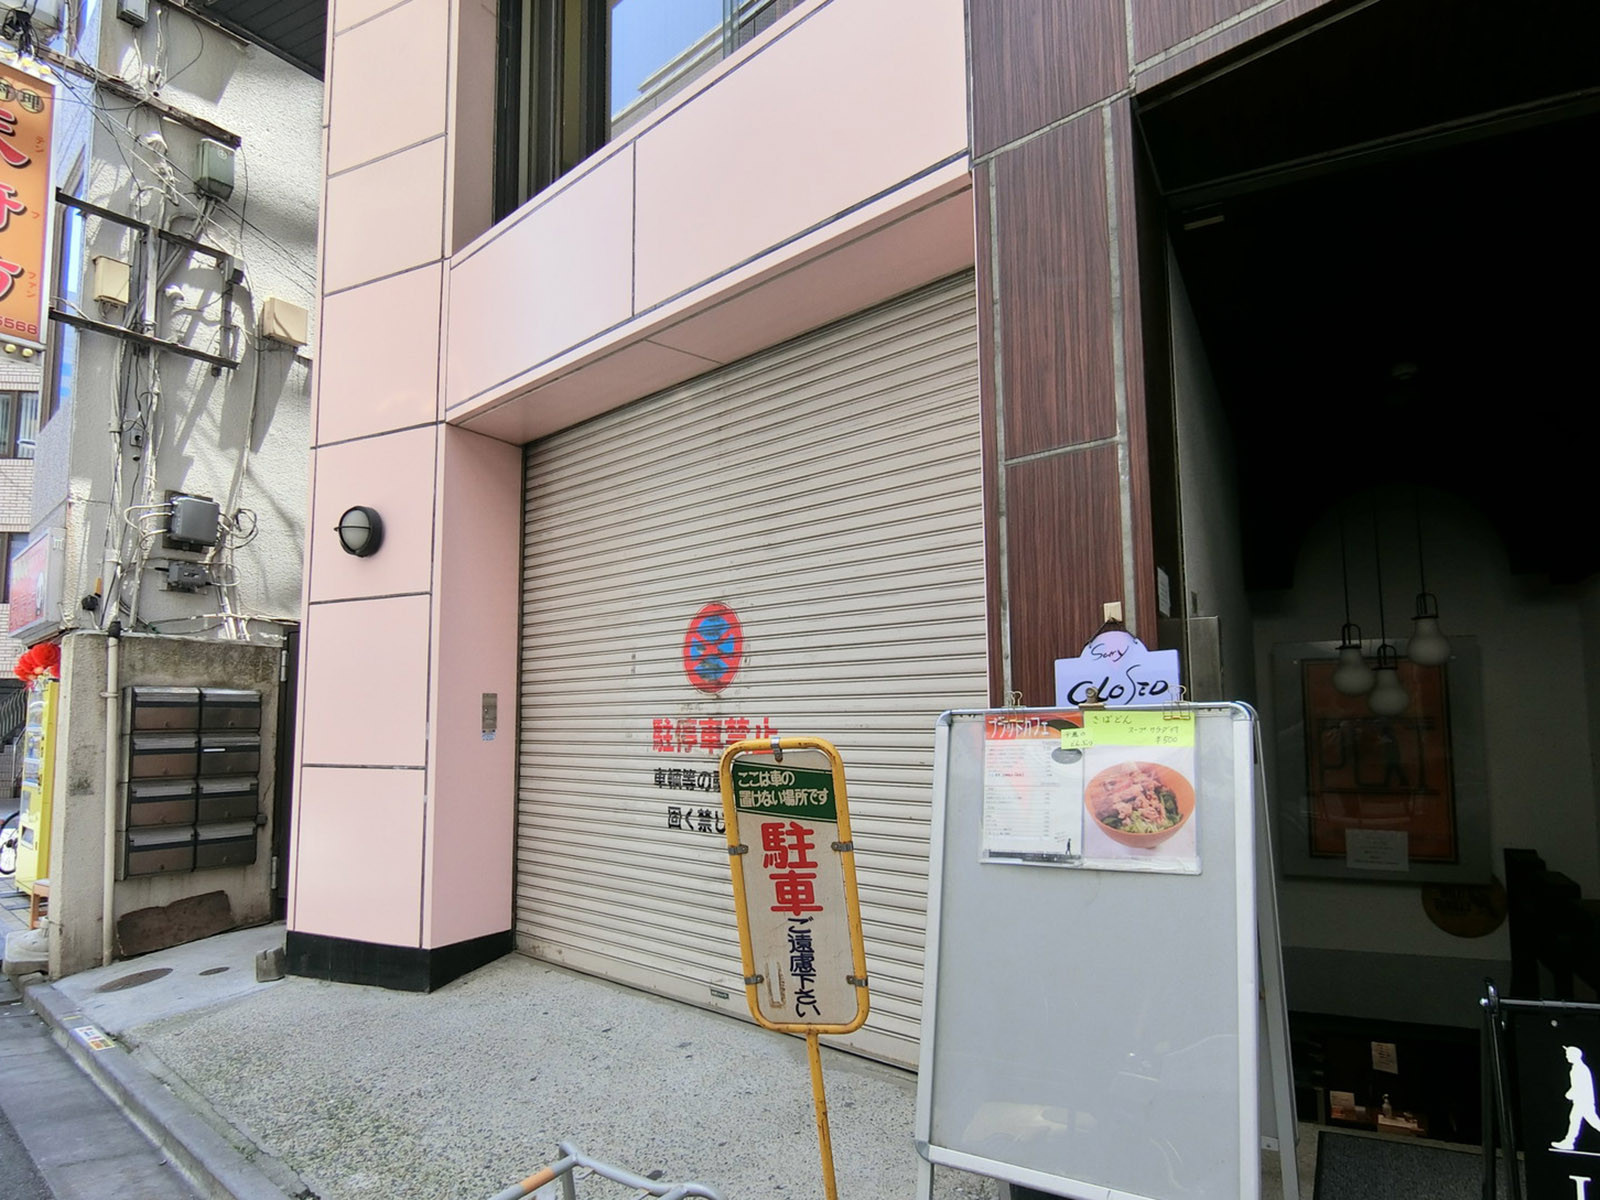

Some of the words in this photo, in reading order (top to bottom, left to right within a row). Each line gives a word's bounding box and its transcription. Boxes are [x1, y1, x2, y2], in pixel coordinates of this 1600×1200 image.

[738, 770, 796, 787] ここは車の
[739, 788, 829, 808] 置けない場所です
[761, 821, 824, 917] 駐車
